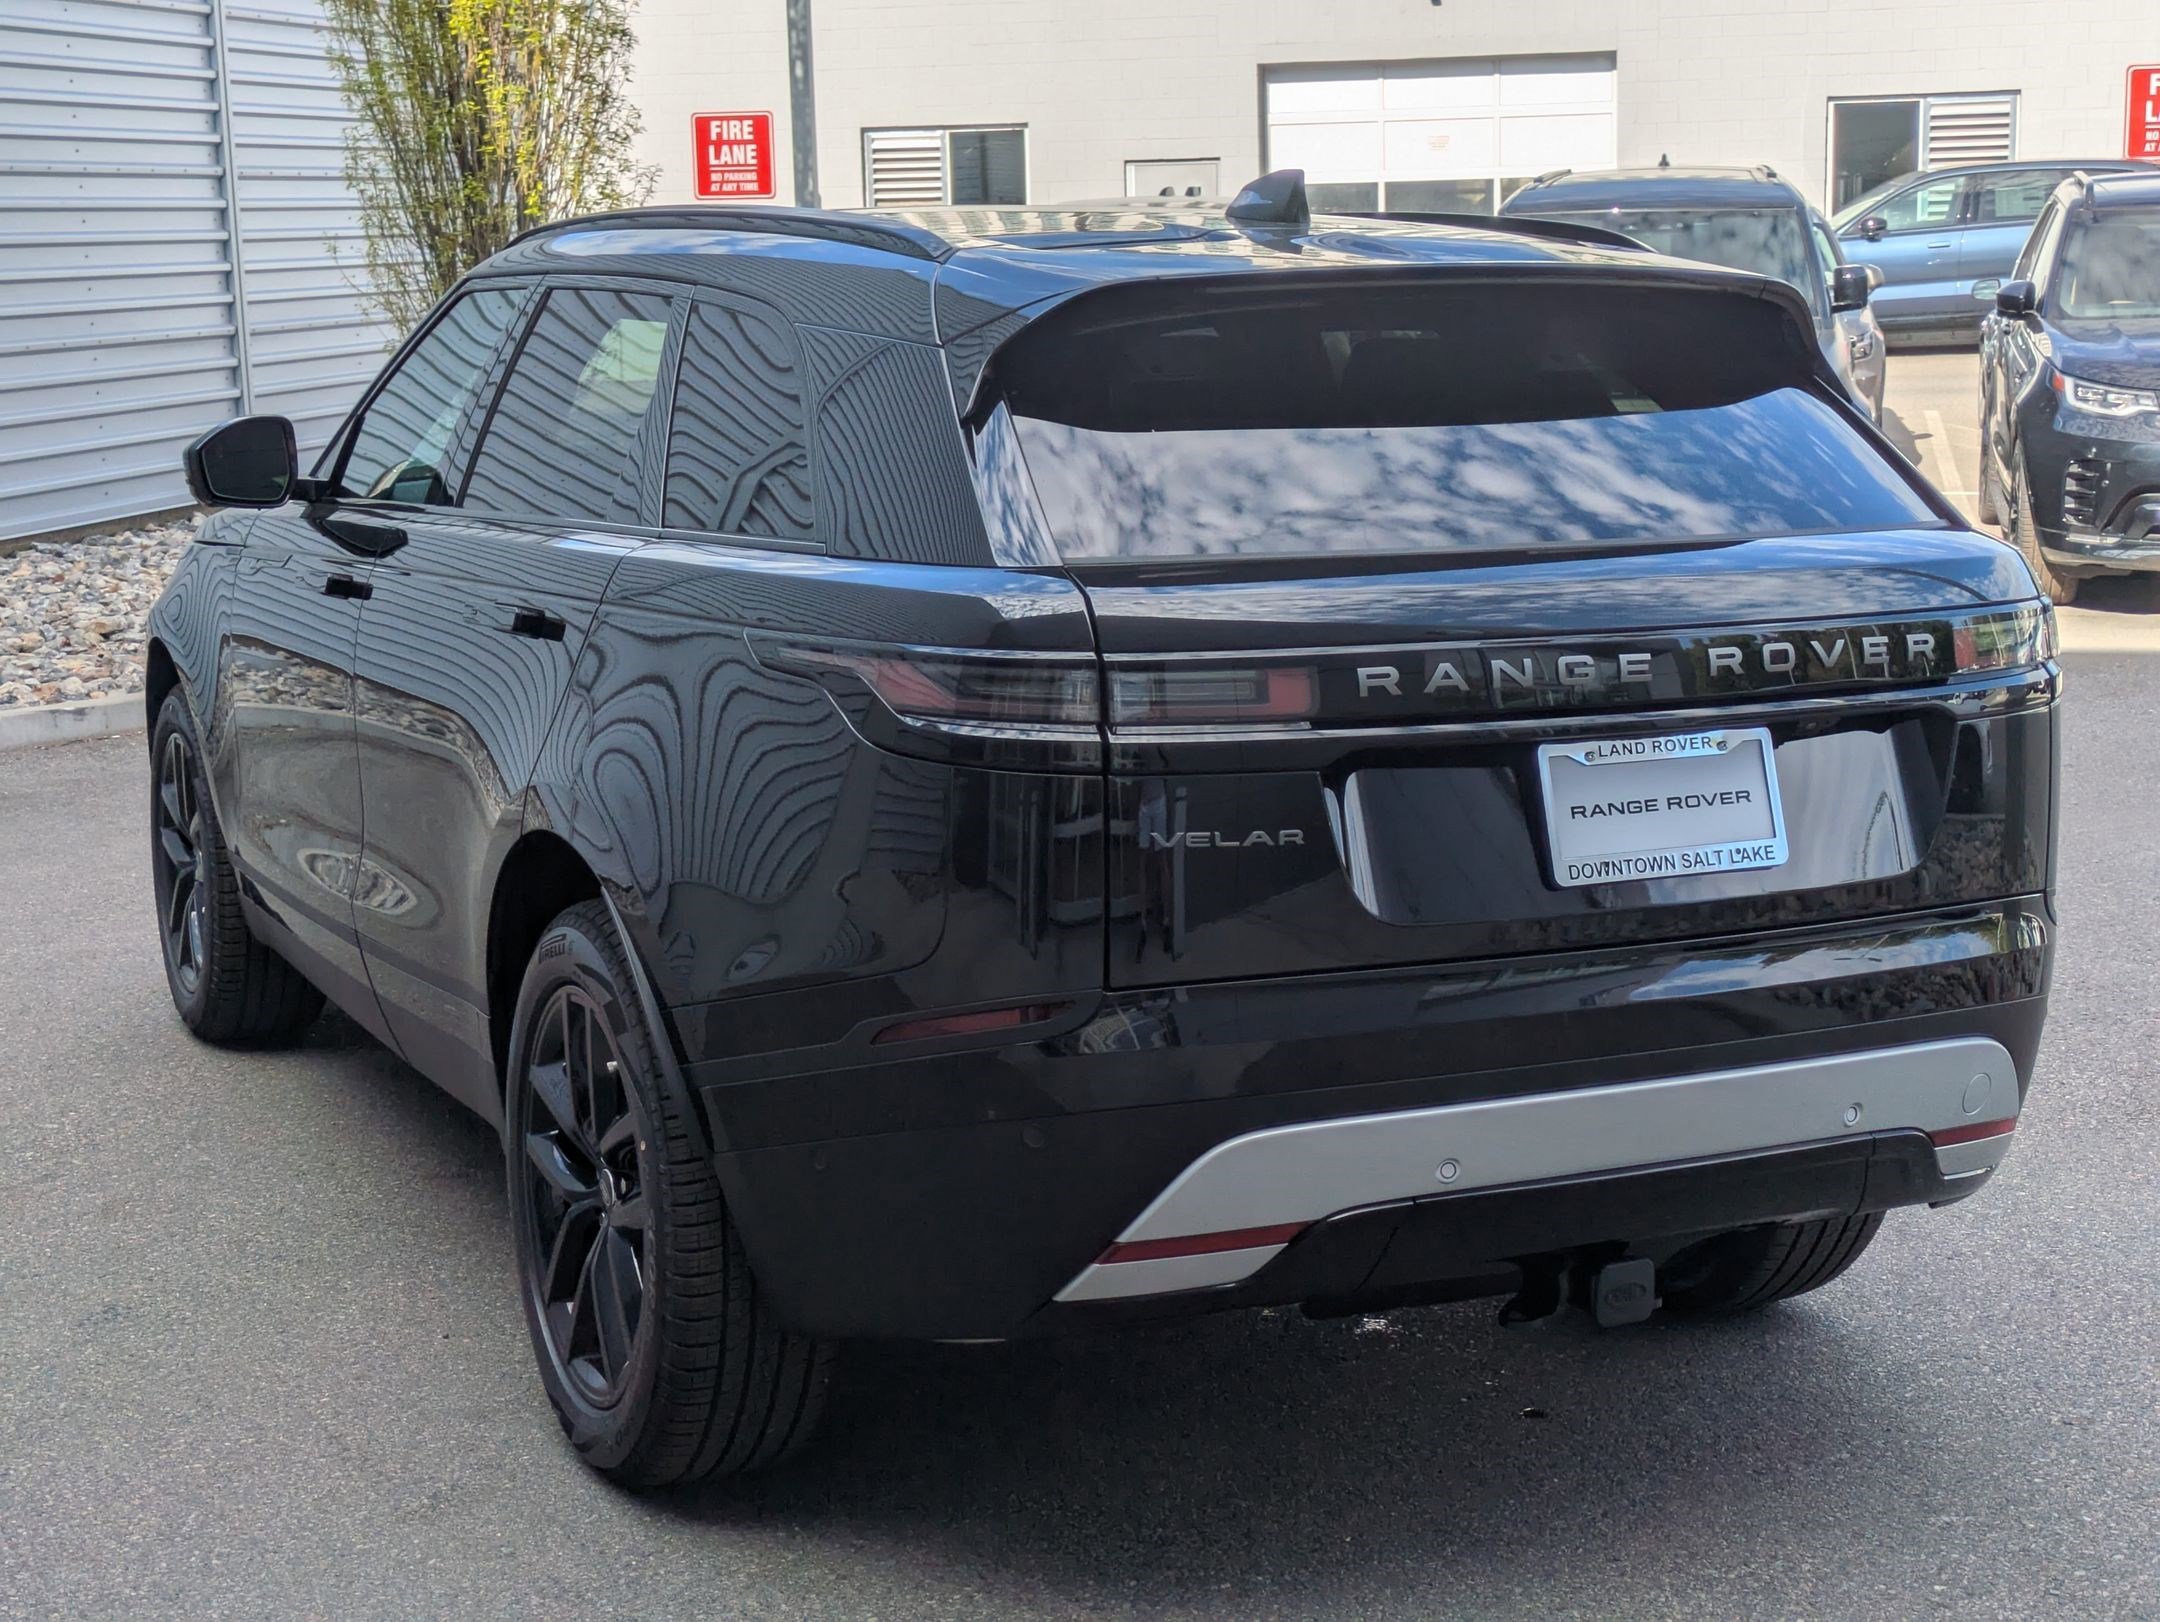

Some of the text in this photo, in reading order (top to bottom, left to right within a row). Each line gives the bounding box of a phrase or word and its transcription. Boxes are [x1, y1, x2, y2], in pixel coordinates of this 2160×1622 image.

[710, 120, 754, 140] FIRE
[709, 144, 757, 165] LANE
[1356, 633, 1936, 697] RANGE ROVER
[1598, 736, 1713, 758] LAND ROVER
[1570, 790, 1752, 819] RANGE ROVER
[1149, 829, 1305, 848] VELAR
[1568, 844, 1776, 880] DOWNTOWN SALT LAKE
[538, 933, 567, 965] PIRELLI
